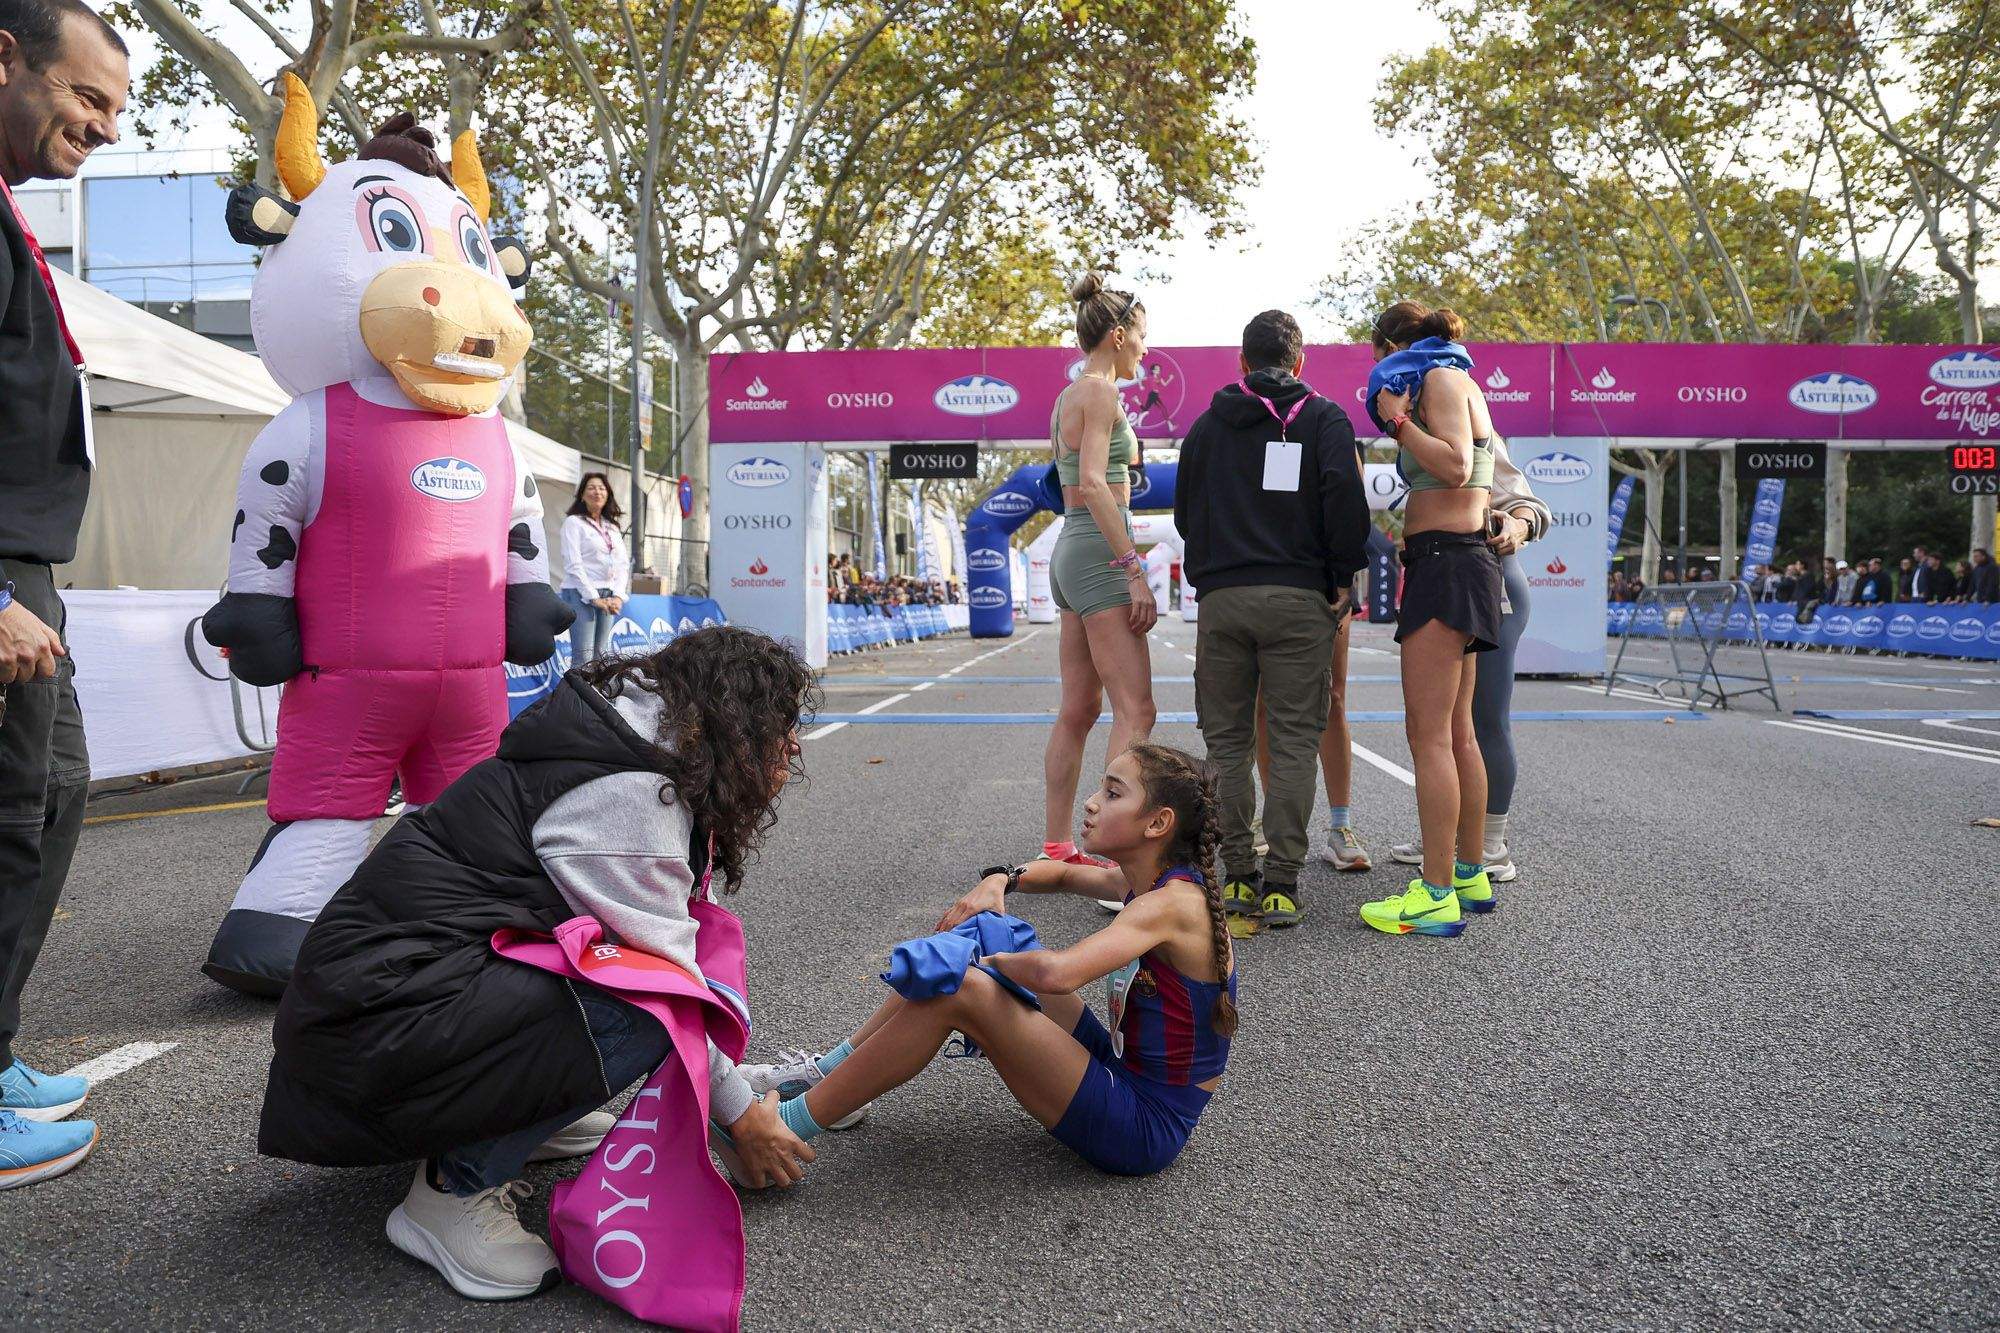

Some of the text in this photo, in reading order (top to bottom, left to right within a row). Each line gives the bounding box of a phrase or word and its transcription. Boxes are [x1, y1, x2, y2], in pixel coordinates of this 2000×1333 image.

[827, 392, 894, 408] OYSHO
[941, 391, 1011, 405] ASTURIANA
[1570, 389, 1637, 402] Santander
[1677, 386, 1747, 402] OYSHO
[1796, 388, 1871, 403] ASTURIANA
[1920, 385, 1988, 406] Carrera
[726, 398, 789, 411] Santander
[1936, 406, 1949, 420] de
[1958, 403, 2000, 436] Muje
[903, 454, 967, 469] OYSHO
[1748, 453, 1814, 469] OYSHO
[732, 470, 786, 480] ASTURIANA
[1529, 465, 1586, 476] ASTURIANA
[418, 470, 481, 490] ASTURIANA
[1951, 474, 2000, 494] OYS
[724, 514, 791, 529] OYSHO
[1551, 512, 1592, 527] SHO
[730, 576, 786, 588] Santander
[1527, 576, 1586, 587] Santander
[593, 1054, 668, 1289] OYSH
